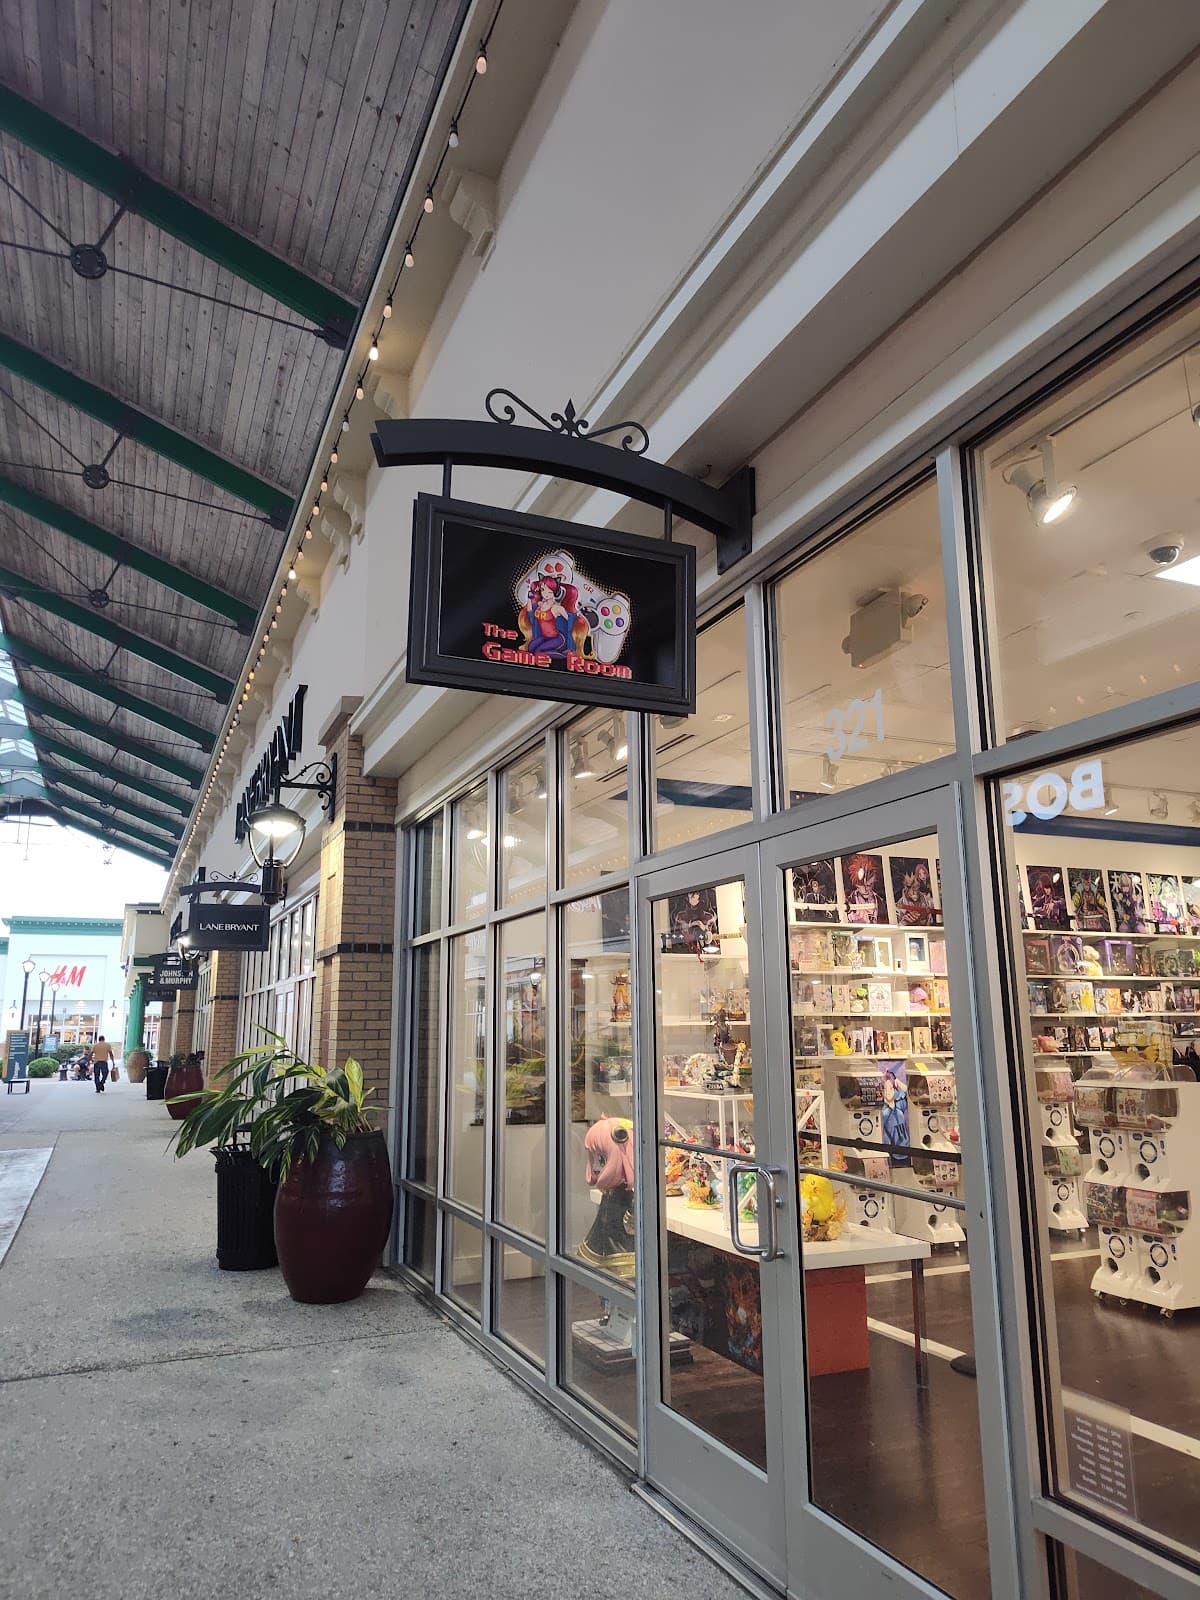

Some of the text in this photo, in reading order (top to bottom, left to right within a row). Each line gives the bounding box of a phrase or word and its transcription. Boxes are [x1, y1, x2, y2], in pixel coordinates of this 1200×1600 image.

[482, 623, 518, 640] The
[482, 641, 633, 680] Game Room
[825, 688, 884, 761] 321
[48, 965, 87, 987] H&M
